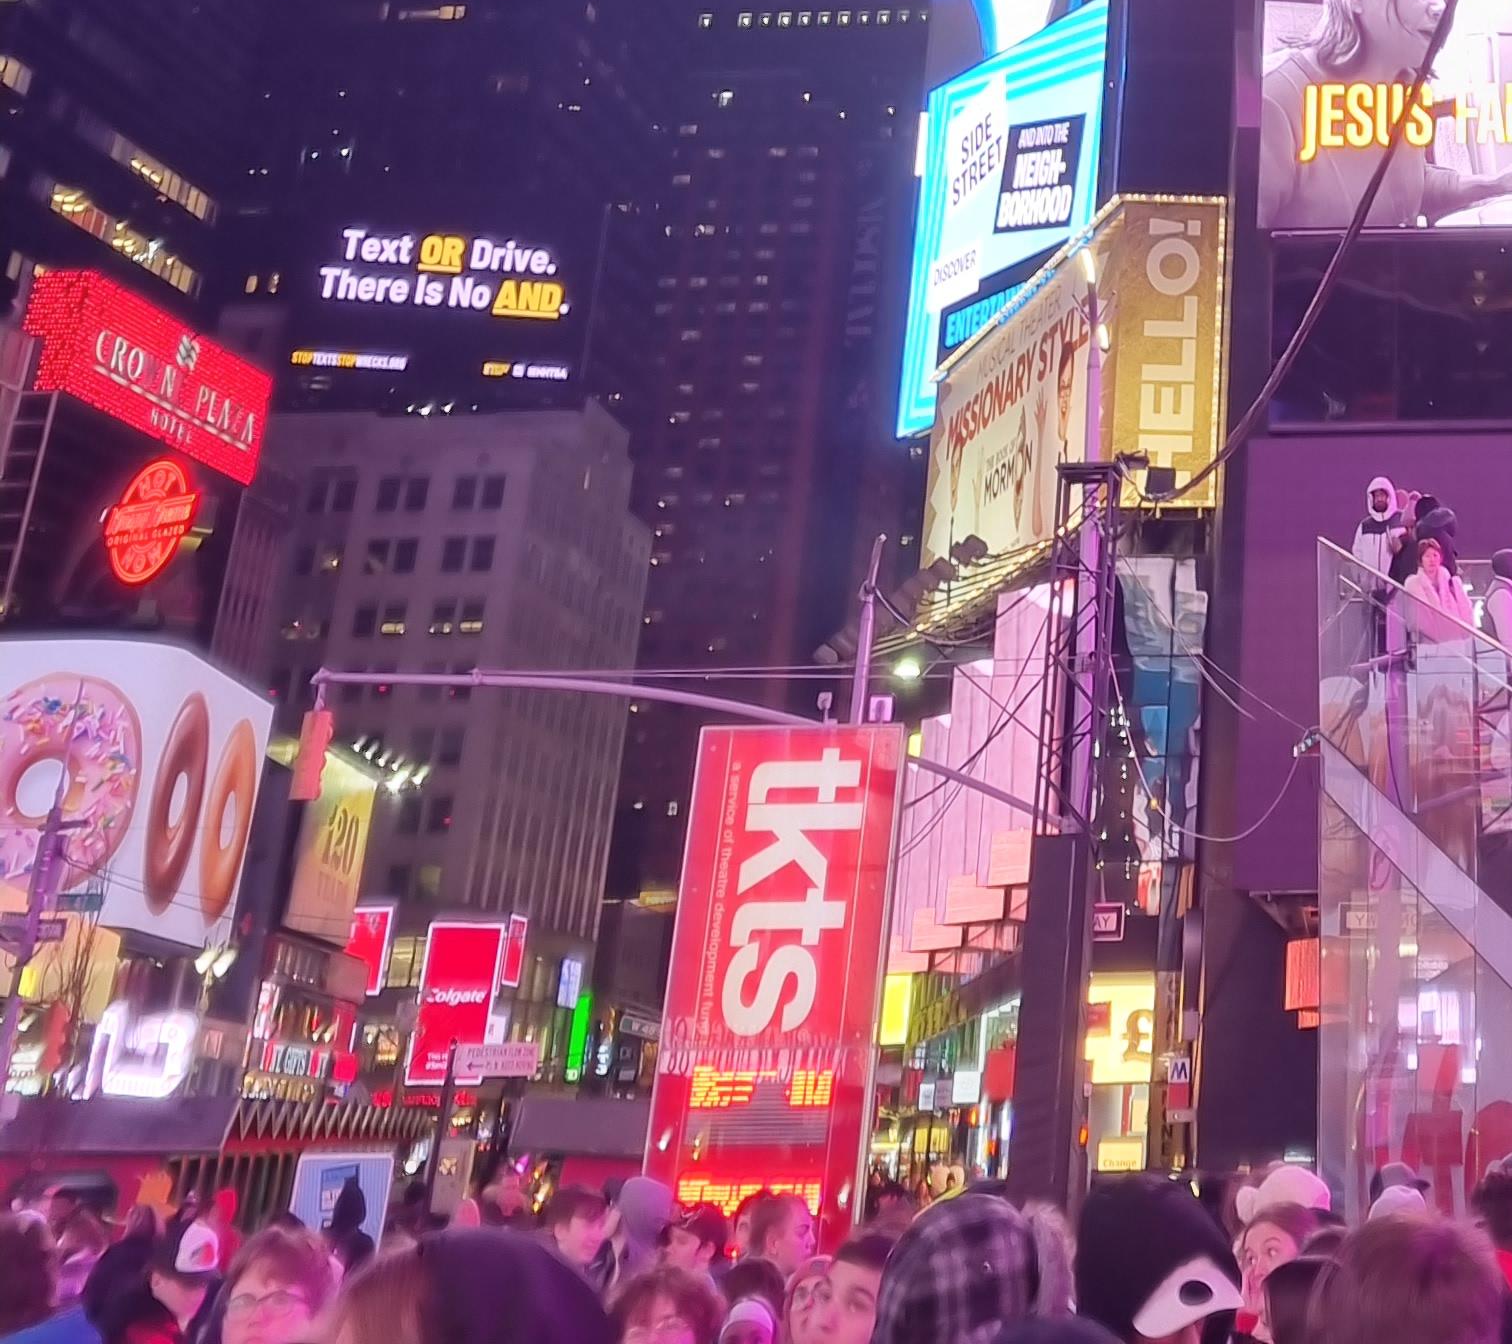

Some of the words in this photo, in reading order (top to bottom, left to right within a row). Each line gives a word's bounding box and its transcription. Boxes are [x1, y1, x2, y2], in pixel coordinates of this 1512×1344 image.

[961, 113, 993, 165] SIDE
[1017, 129, 1036, 150] AND
[1053, 122, 1070, 144] THE
[952, 135, 1003, 207] STREET
[1012, 148, 1067, 190] NEIGH-
[996, 185, 1073, 228] BORHOOD
[343, 227, 415, 265] Text
[417, 234, 466, 268] OR
[470, 239, 557, 276] Drive.
[933, 249, 977, 287] DISCOVER
[319, 267, 409, 304] There
[414, 278, 443, 307] Is
[448, 277, 491, 310] No
[492, 280, 571, 318] AND.
[946, 346, 1035, 461] MISSIONARY
[1036, 290, 1092, 384] STYLE
[1135, 217, 1202, 497] HELLO!
[151, 408, 194, 444] HOTEL
[196, 384, 257, 443] PLAZA
[139, 470, 177, 501] HOT
[984, 439, 1033, 507] MORMON
[121, 542, 163, 573] NOW
[727, 773, 742, 825] service
[725, 829, 736, 844] of
[716, 847, 734, 898] theatre
[722, 748, 864, 1037] tkts
[704, 902, 727, 999] development
[427, 987, 488, 1007] Colgate
